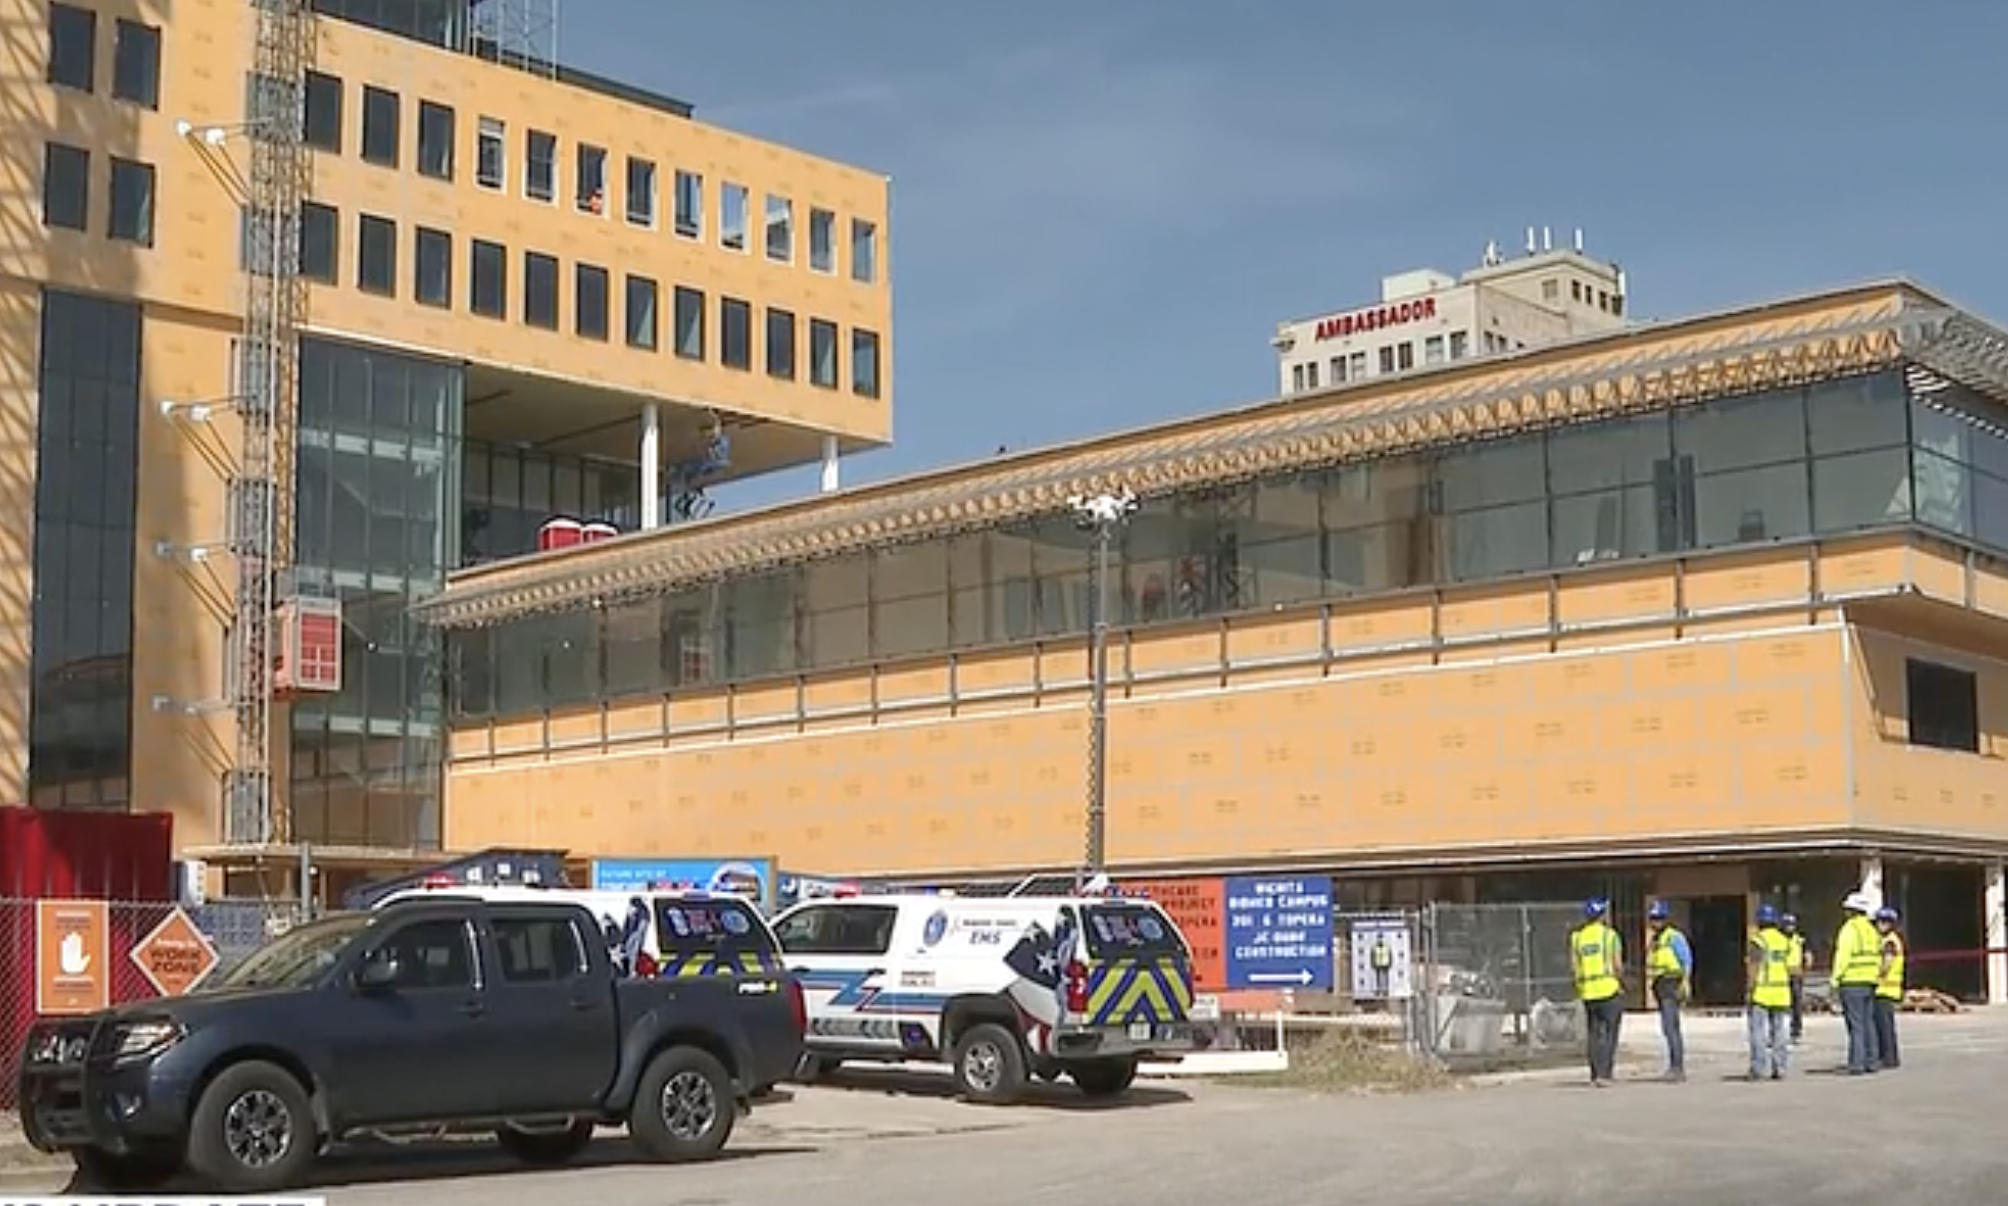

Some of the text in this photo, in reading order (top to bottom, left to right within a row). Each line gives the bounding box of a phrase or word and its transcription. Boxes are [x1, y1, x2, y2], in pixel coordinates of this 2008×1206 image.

[1315, 297, 1436, 343] AMBASSADOR
[969, 930, 1002, 945] EMS
[1234, 944, 1327, 960] CONSTRUCTION
